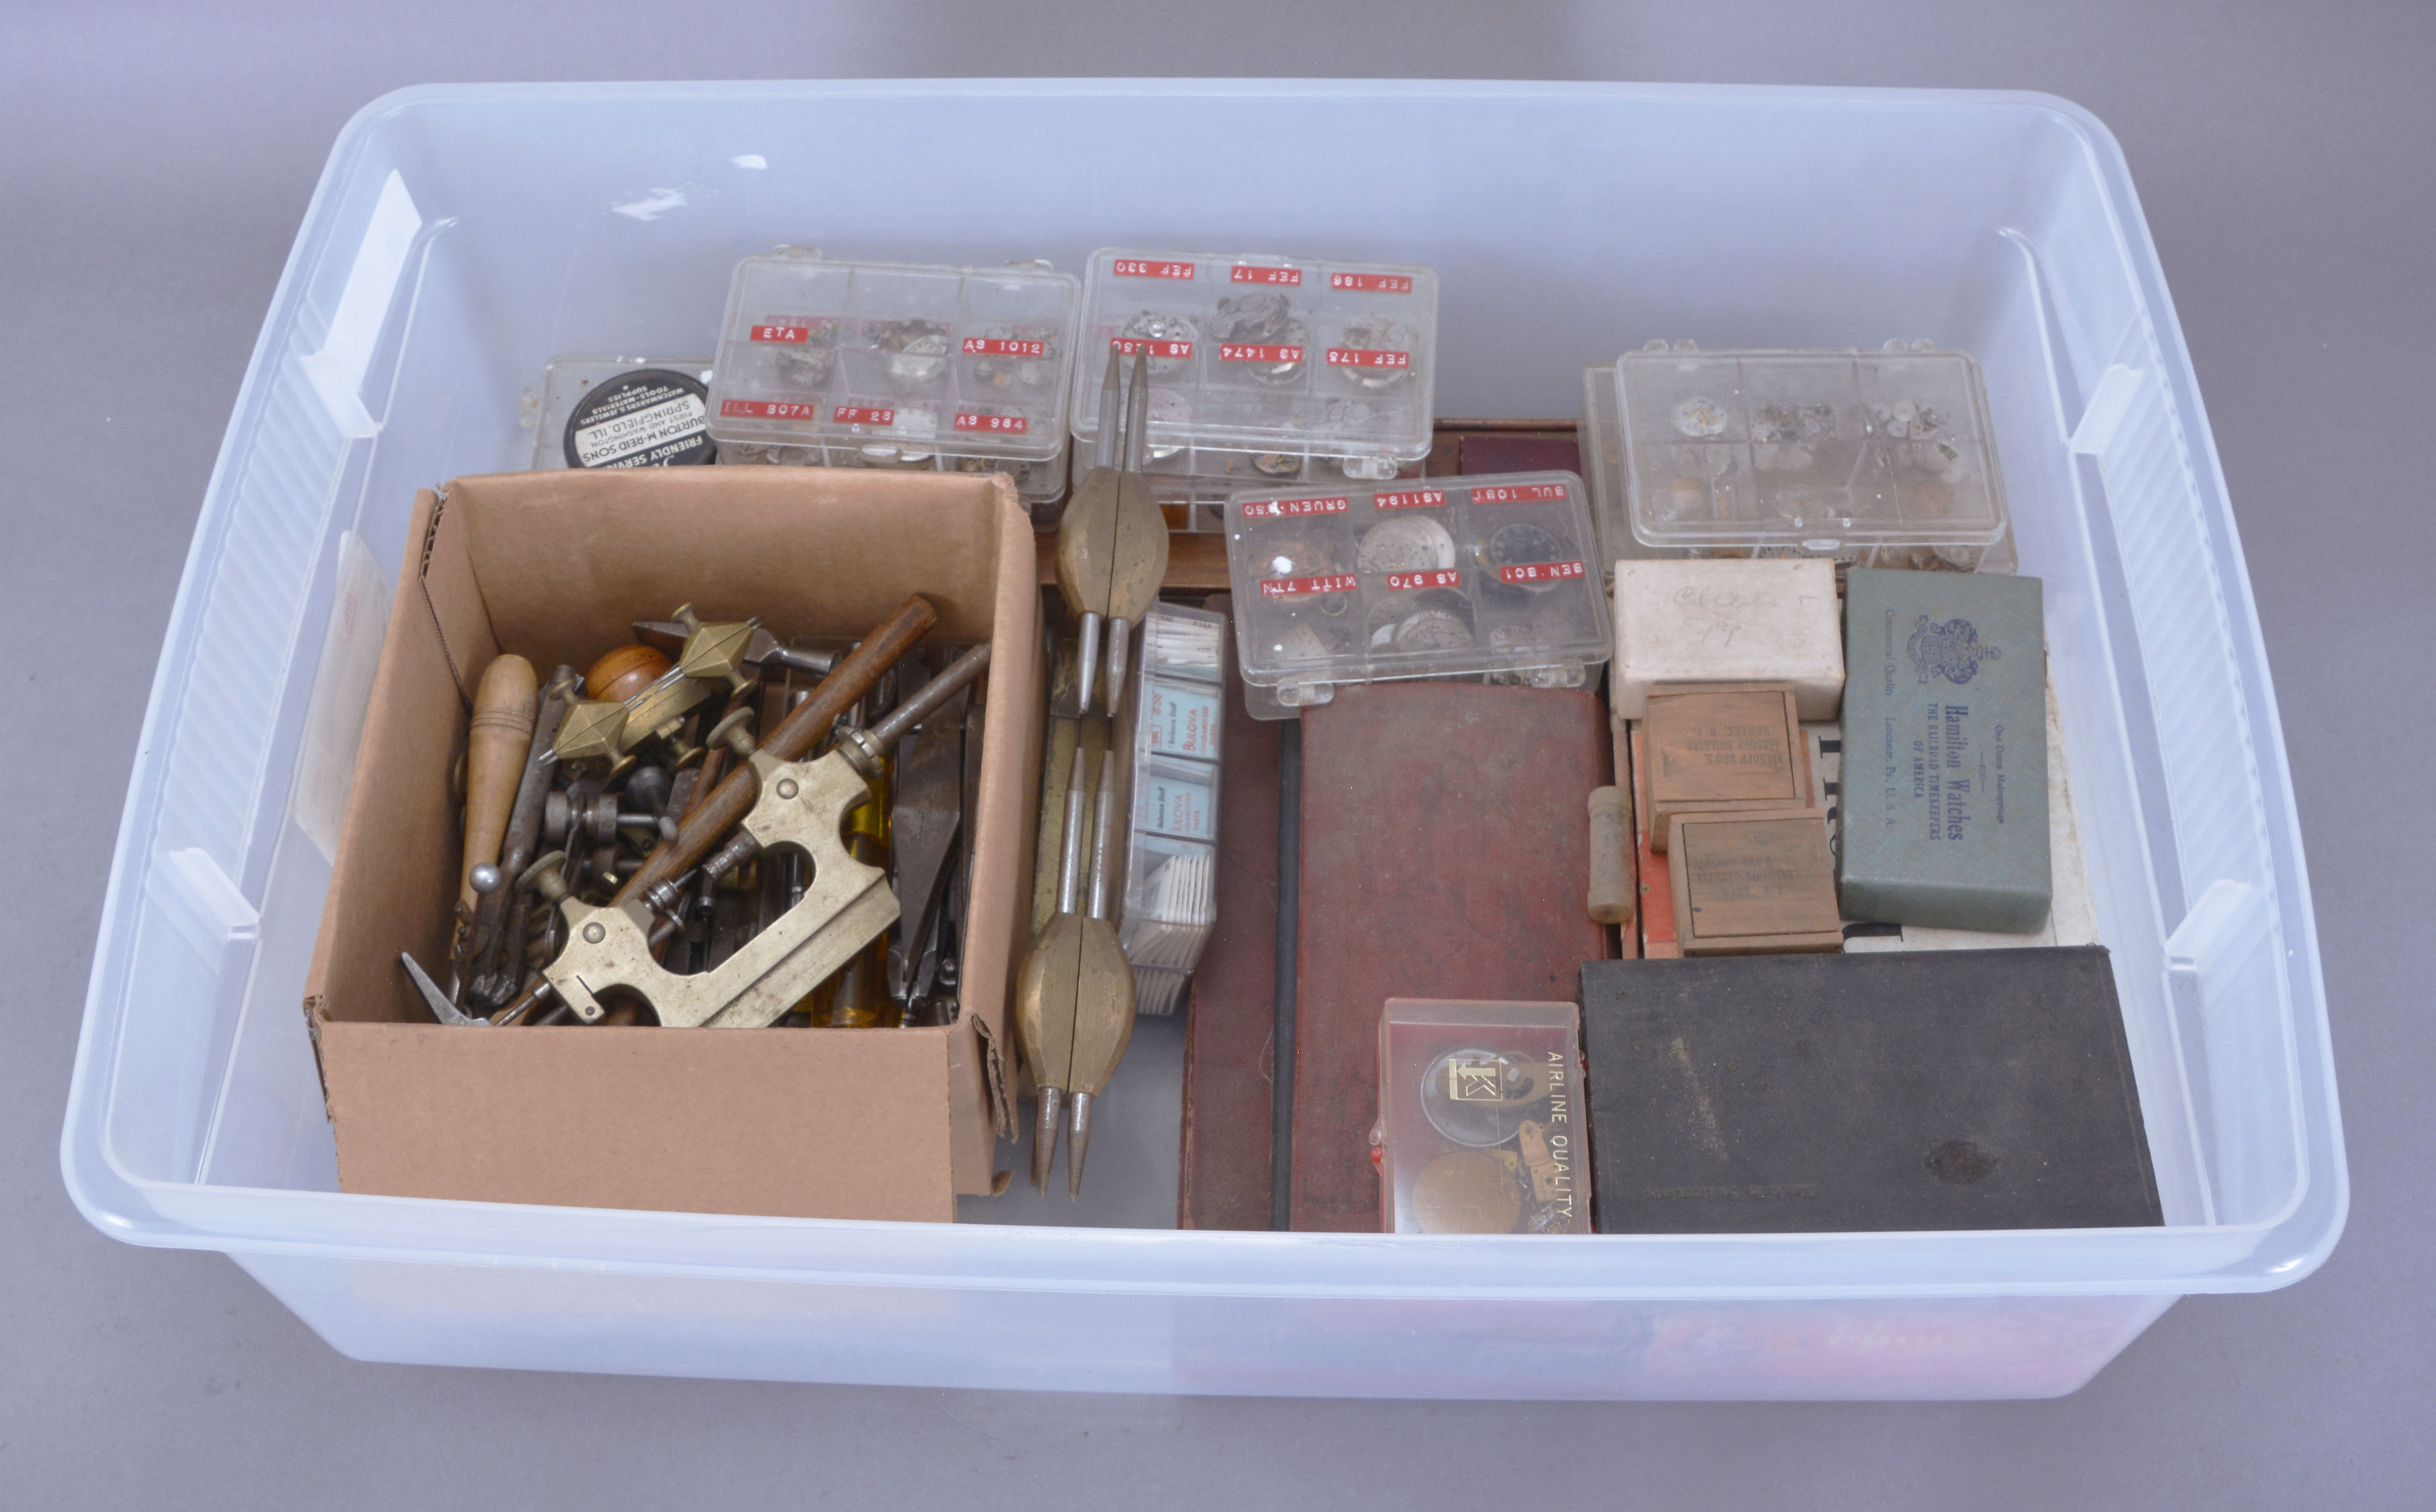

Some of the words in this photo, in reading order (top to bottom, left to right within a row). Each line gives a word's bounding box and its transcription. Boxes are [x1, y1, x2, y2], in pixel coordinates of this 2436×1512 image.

[1117, 262, 1147, 274] 330
[1160, 264, 1192, 278] FEF
[1234, 269, 1252, 280] 17
[1268, 271, 1299, 283] FEF
[1333, 276, 1363, 287] 186
[1378, 279, 1409, 290] FEF
[763, 327, 796, 340] ETA
[964, 340, 985, 349] AS
[1000, 342, 1040, 354] 1012
[1170, 344, 1190, 354] AS
[1223, 347, 1264, 359] 1474
[1279, 348, 1300, 359] AS
[1329, 351, 1360, 363] 175
[1374, 354, 1406, 365] FEF
[608, 385, 647, 402] SUPPLIES
[627, 387, 683, 411] WATCHMAKERS
[580, 409, 618, 424] JEWELERS
[669, 410, 692, 422] FIRST
[837, 408, 858, 419] FF
[649, 419, 665, 428] AND
[660, 416, 705, 439] BURTON
[957, 415, 977, 425] AS
[991, 418, 1023, 429] 984
[591, 426, 647, 448] WASHINGTON
[582, 445, 615, 463] SONS
[650, 435, 703, 461] FRIENDLY
[1531, 486, 1564, 498] BUL
[1290, 499, 1346, 513] GRUEN
[1550, 563, 1582, 577] BEN
[1311, 576, 1356, 590] WITT
[1390, 574, 1423, 588] 970
[1437, 572, 1457, 584] AS
[1885, 609, 1895, 661] Commercial
[1884, 665, 1895, 697] Quality
[1928, 703, 1938, 720] THE
[1885, 717, 1895, 762] Lancaster,
[1946, 706, 1969, 768] Hamilton
[1995, 724, 2003, 742] One
[1914, 741, 1923, 752] OF
[1928, 725, 1939, 770] RAILROAD
[1995, 745, 2004, 770] Dozen
[1914, 758, 1924, 798] AMERICA
[1996, 774, 2005, 824] Mainsprings
[1929, 775, 1940, 840] TIMEKEEPERS
[1947, 779, 1971, 840] Watches
[1548, 1051, 1567, 1123] AIRLINE
[1550, 1135, 1572, 1217] QUALITY
